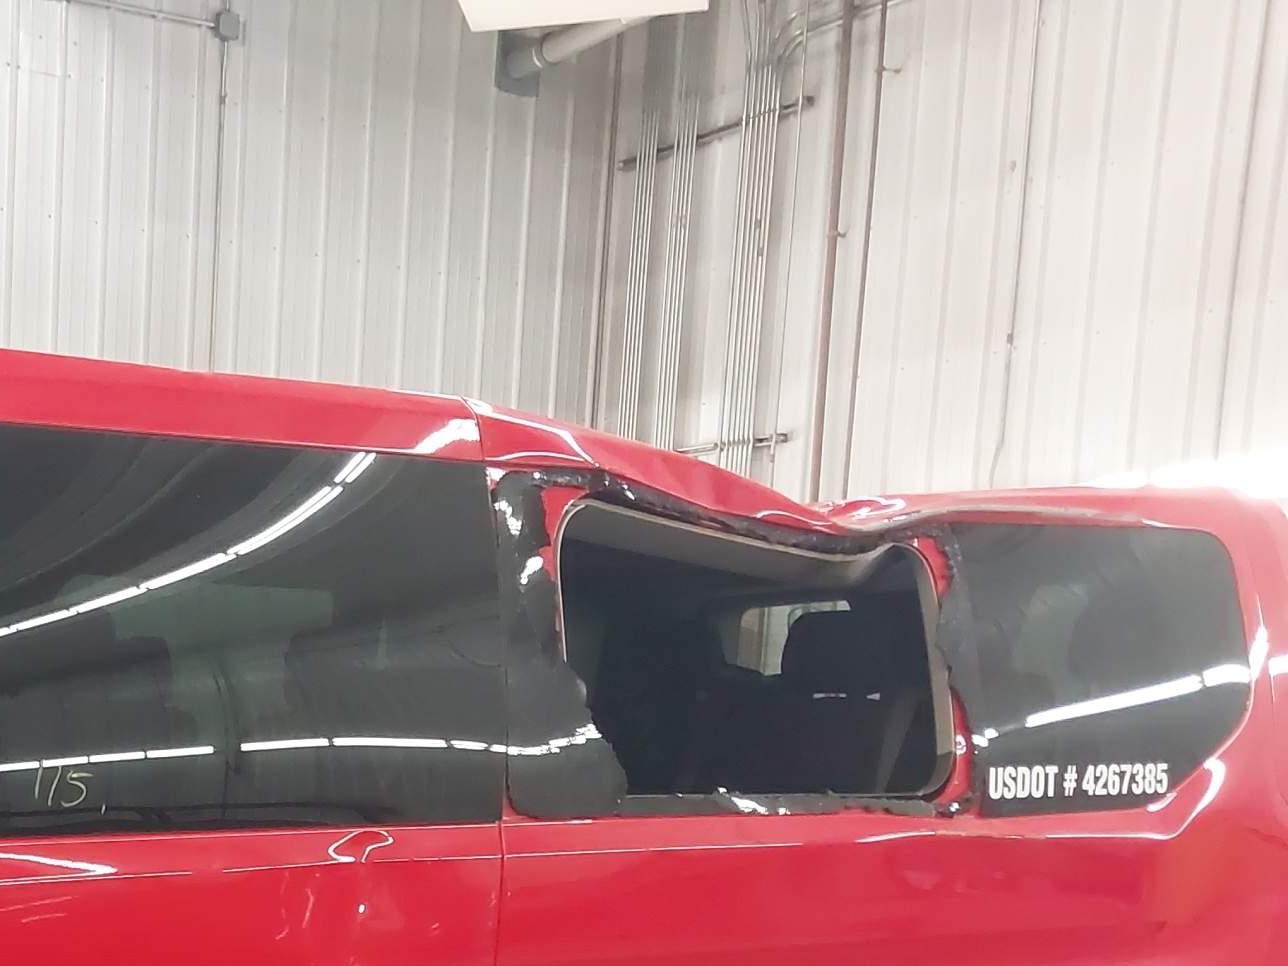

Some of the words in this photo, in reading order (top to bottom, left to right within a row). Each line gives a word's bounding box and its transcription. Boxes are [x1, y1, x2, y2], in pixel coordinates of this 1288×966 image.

[988, 766, 1059, 800] USDOT
[1063, 765, 1077, 797] #
[1082, 763, 1169, 797] 4267385
